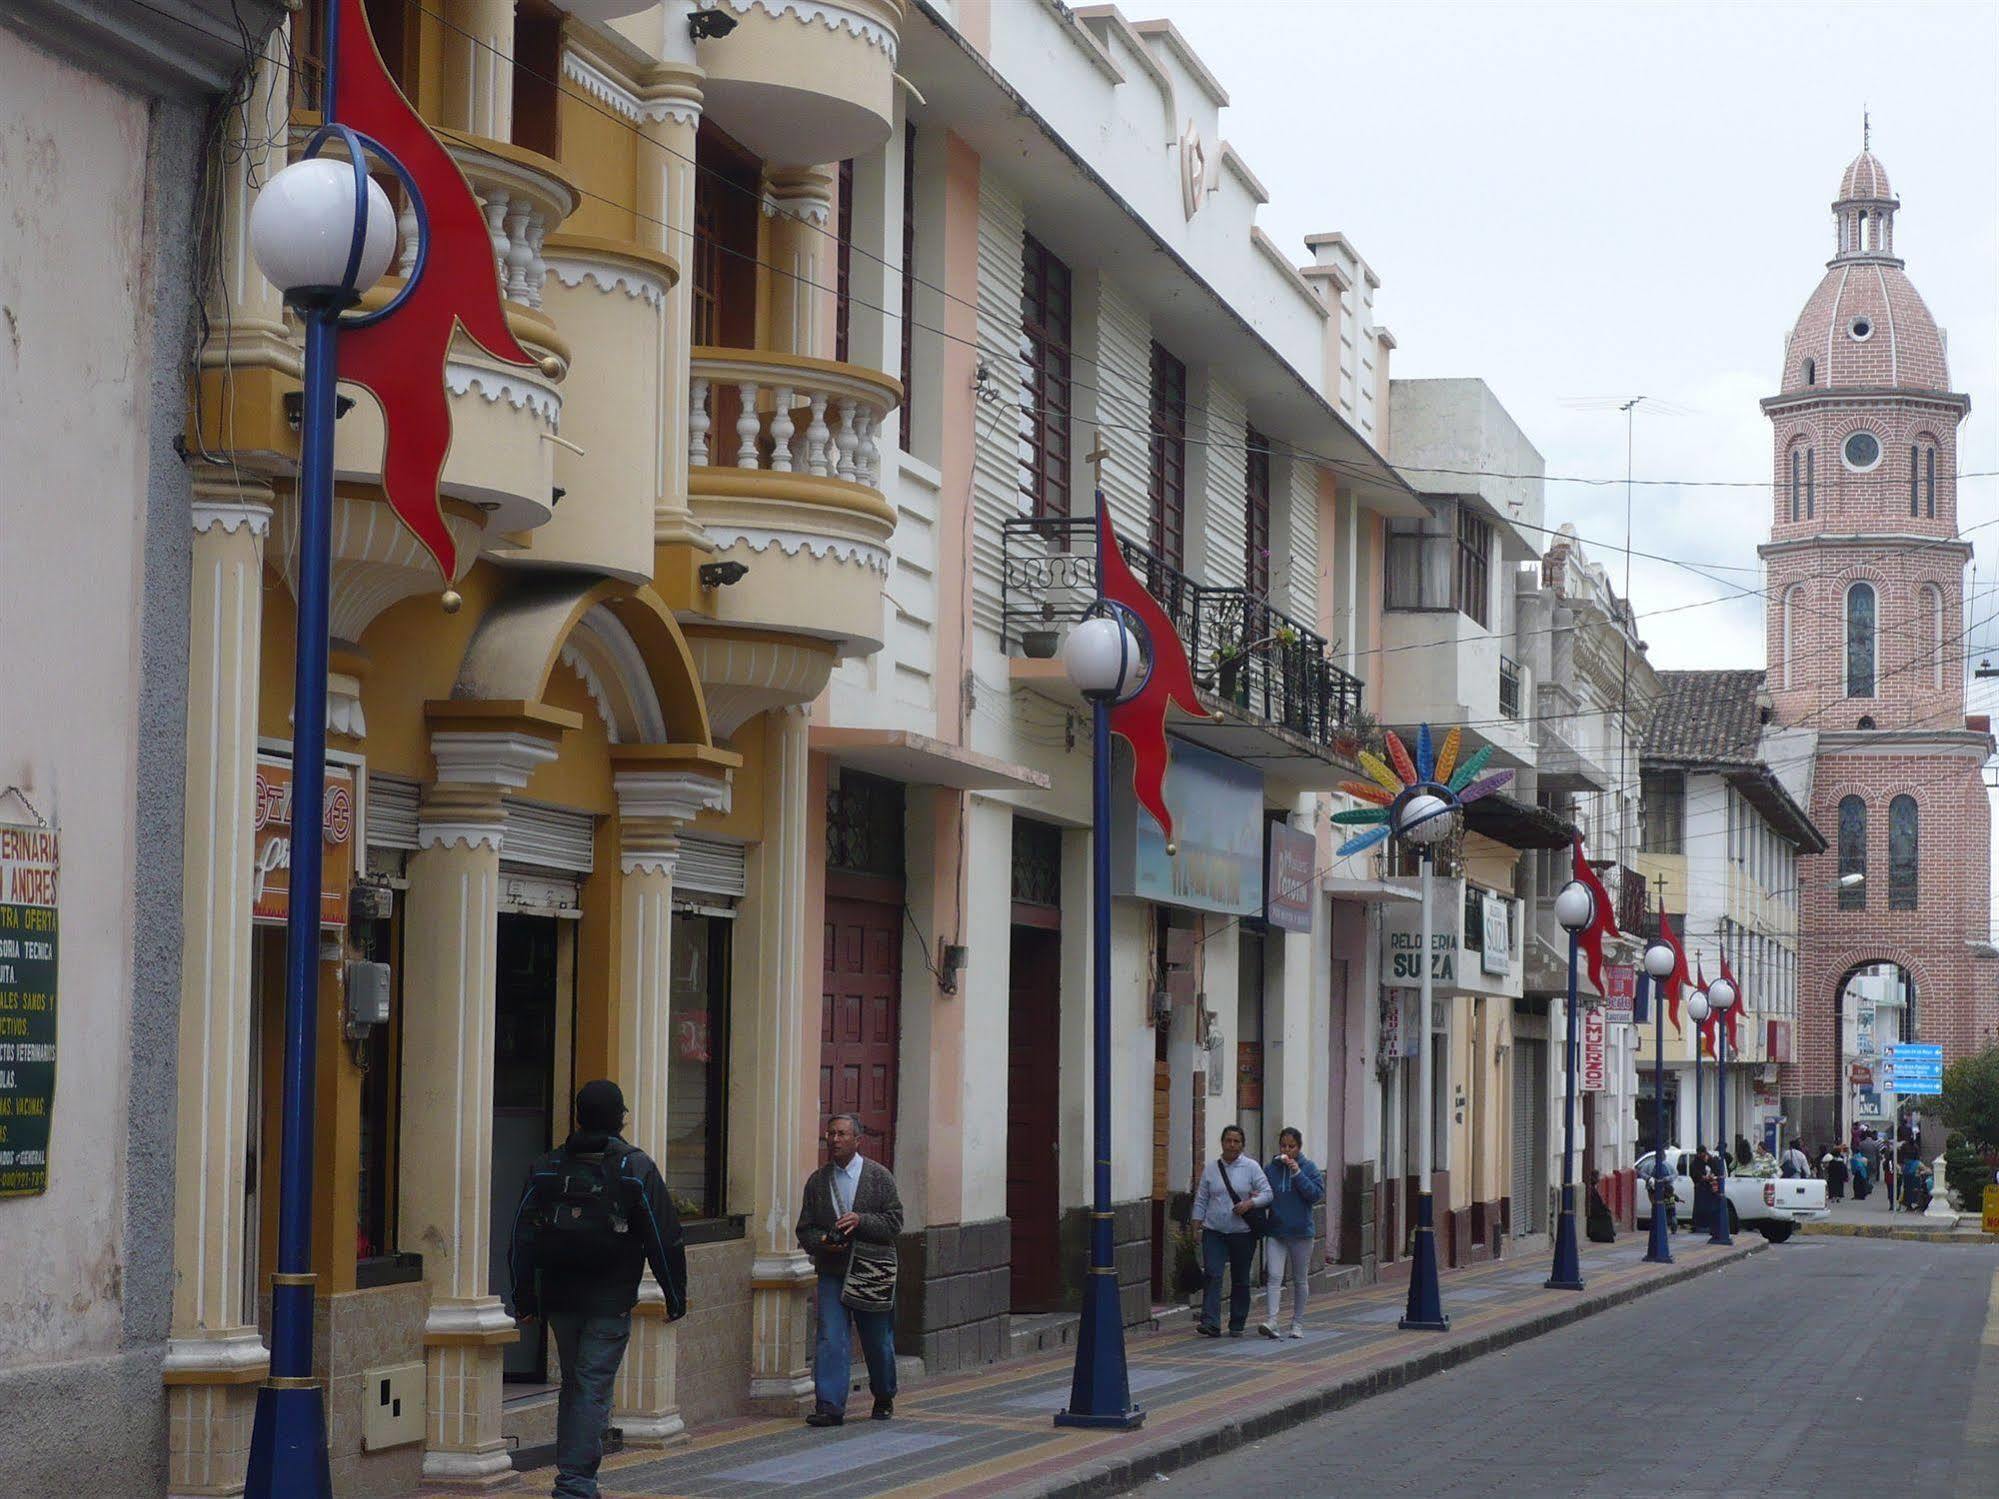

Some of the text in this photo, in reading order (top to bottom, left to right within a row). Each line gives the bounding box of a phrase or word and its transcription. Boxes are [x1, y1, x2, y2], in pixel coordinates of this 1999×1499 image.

[0, 828, 59, 863] ERINARIA
[11, 867, 57, 905] ANDRES
[24, 908, 57, 932] OFERTA
[24, 941, 53, 960] TECNICA
[1391, 932, 1458, 951] RELOERIA
[1393, 953, 1453, 980] SUZA
[22, 992, 46, 1011] SANOS
[1585, 1008, 1603, 1089] ALMUERZOS
